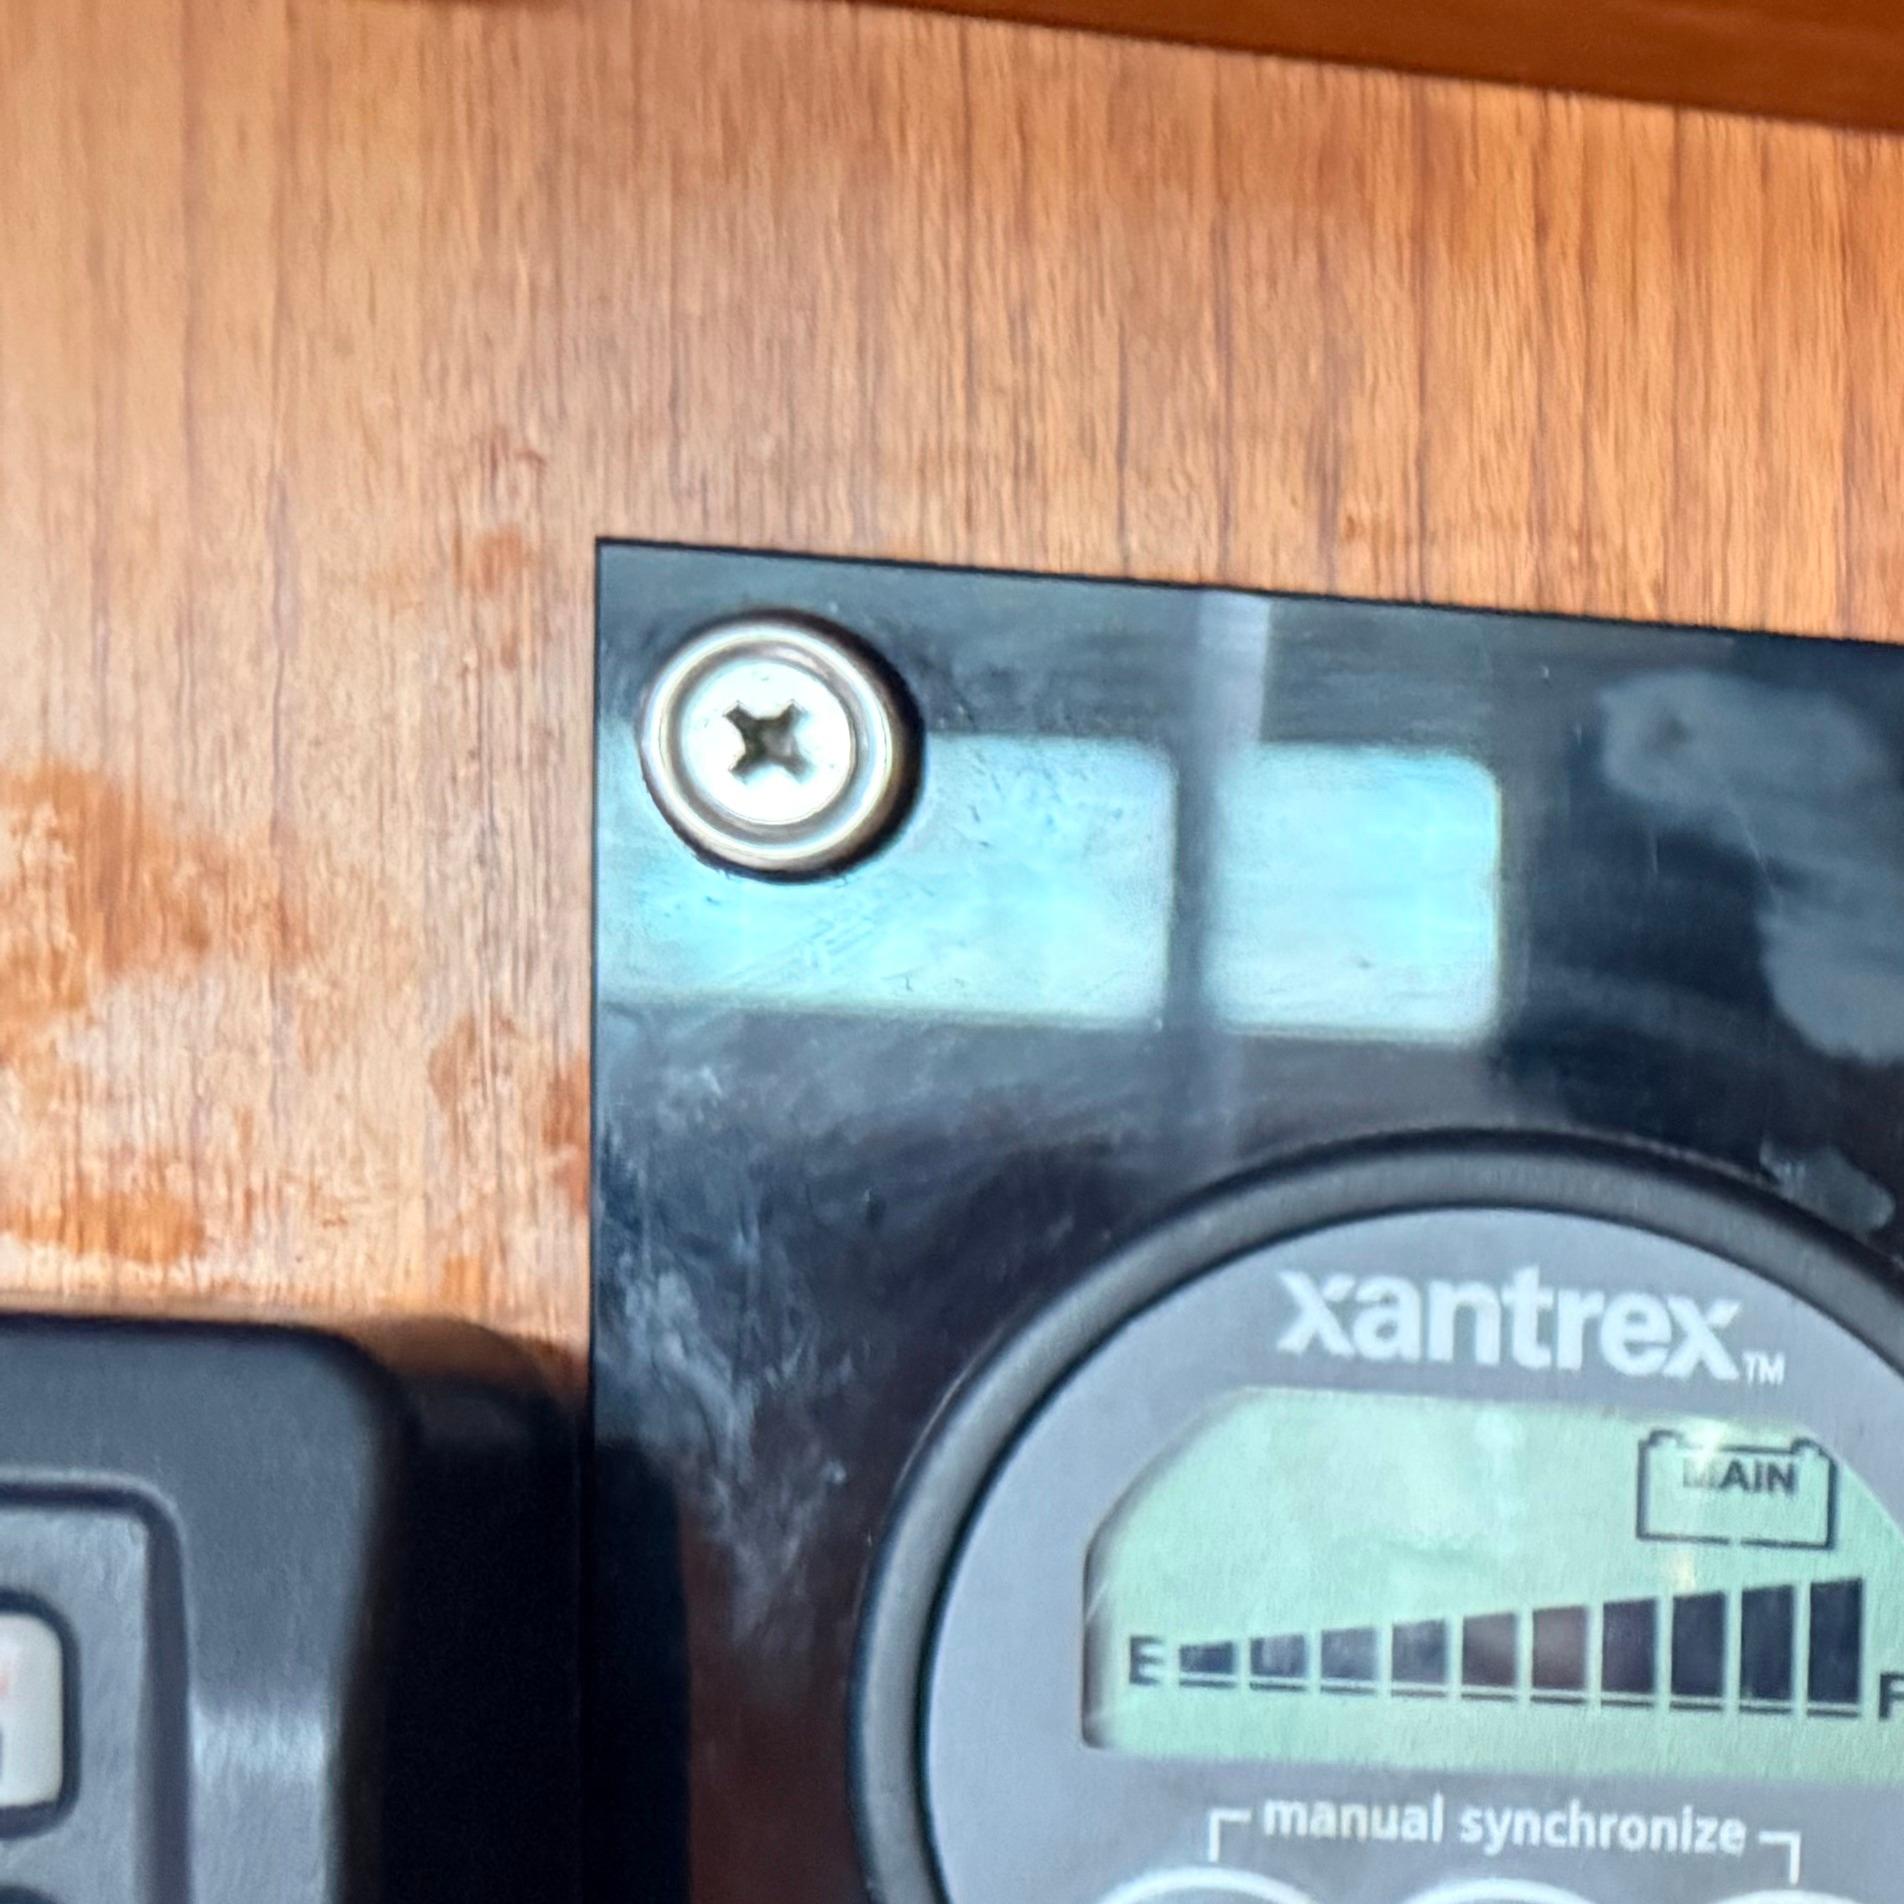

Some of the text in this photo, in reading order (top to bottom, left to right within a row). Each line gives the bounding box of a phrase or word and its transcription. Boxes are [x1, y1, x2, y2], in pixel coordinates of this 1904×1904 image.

[1278, 1264, 1744, 1384] xantrex
[1128, 1634, 1166, 1688] E
[1262, 1796, 1748, 1858] manual synchronize
